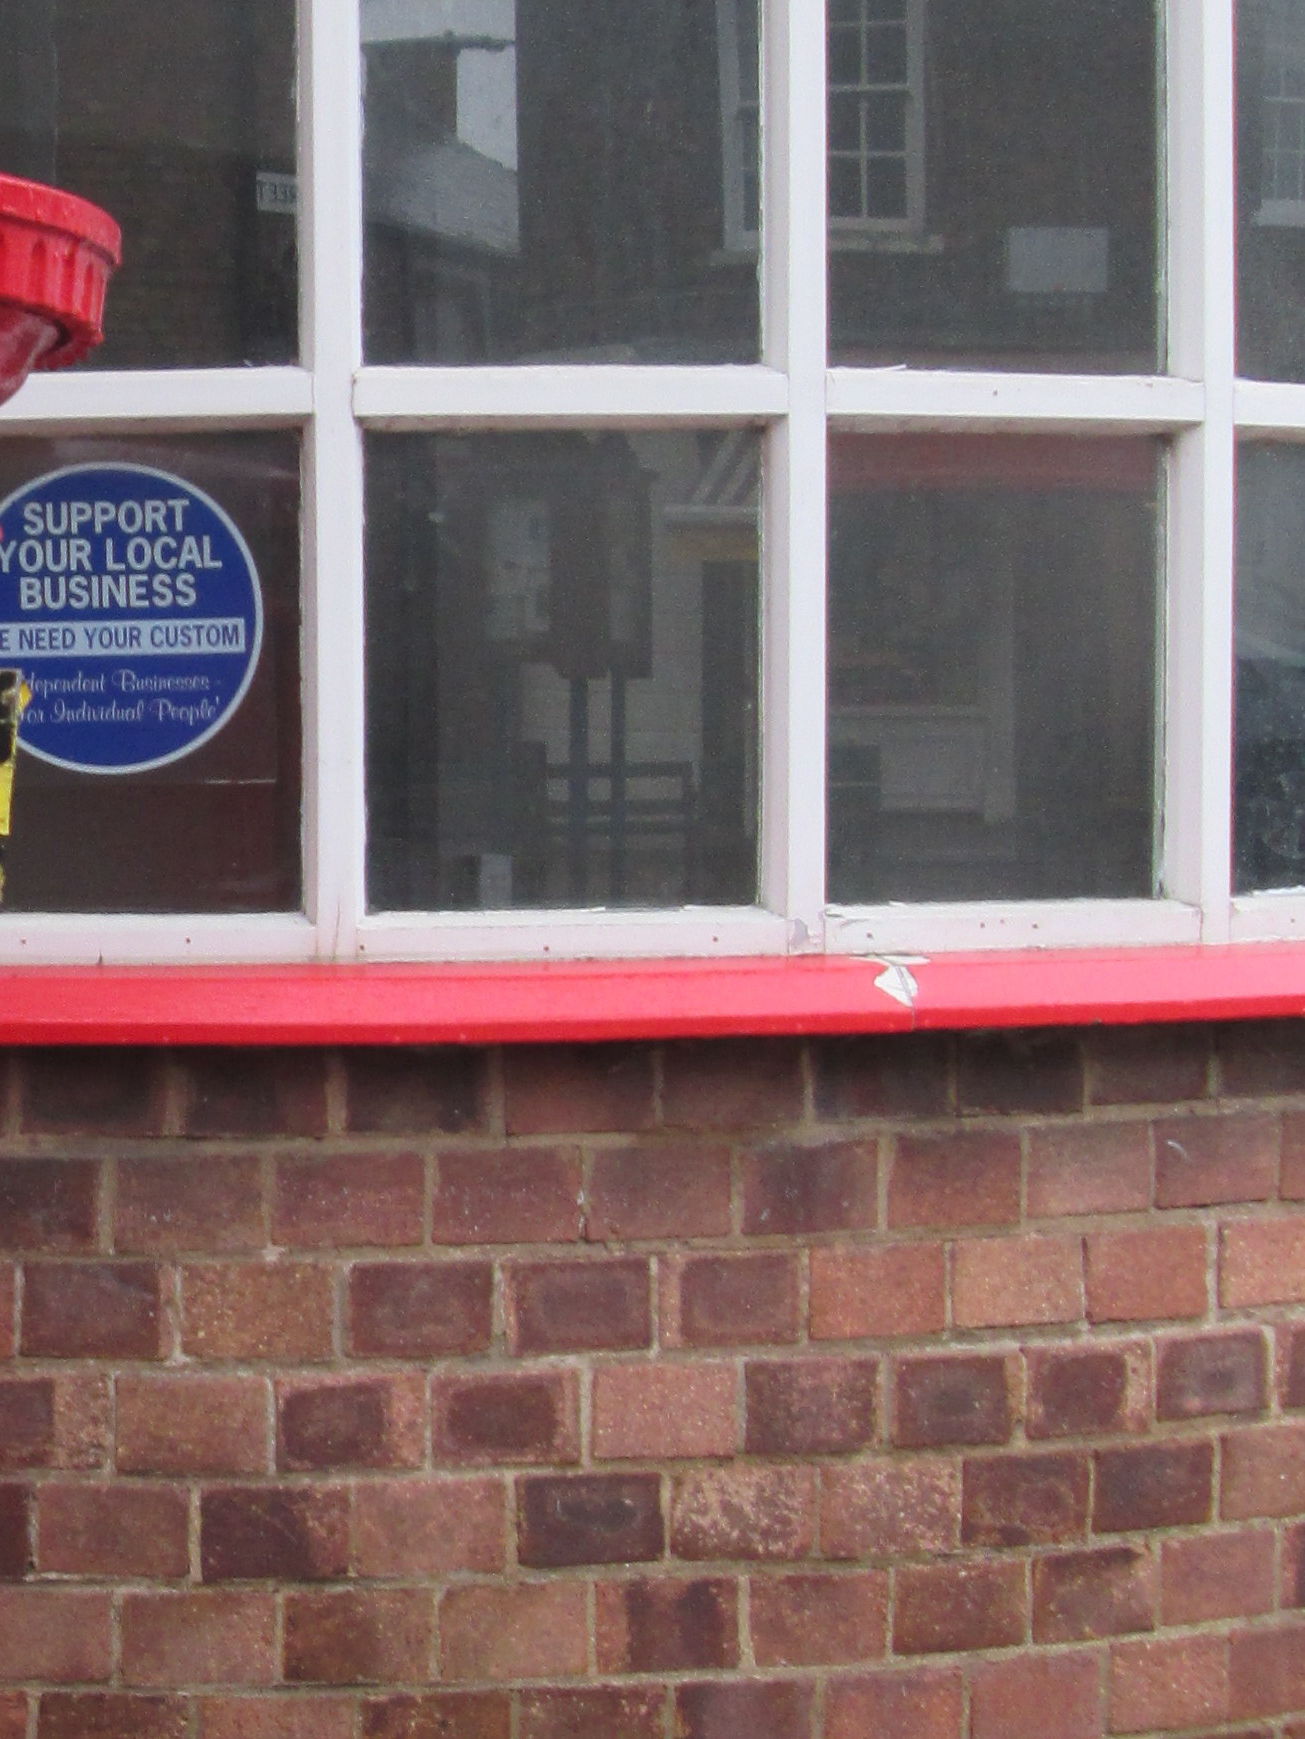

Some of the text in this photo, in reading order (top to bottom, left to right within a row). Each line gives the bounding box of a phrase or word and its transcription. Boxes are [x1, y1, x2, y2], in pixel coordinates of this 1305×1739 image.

[23, 499, 190, 535] SUPPORT
[105, 535, 222, 572] LOCAL
[20, 573, 197, 611] BUSINESS
[19, 626, 75, 650] NEED
[84, 625, 142, 648] YOUR
[150, 623, 240, 647] CUSTOM
[112, 669, 210, 692] Businesses
[51, 698, 144, 723] Individual
